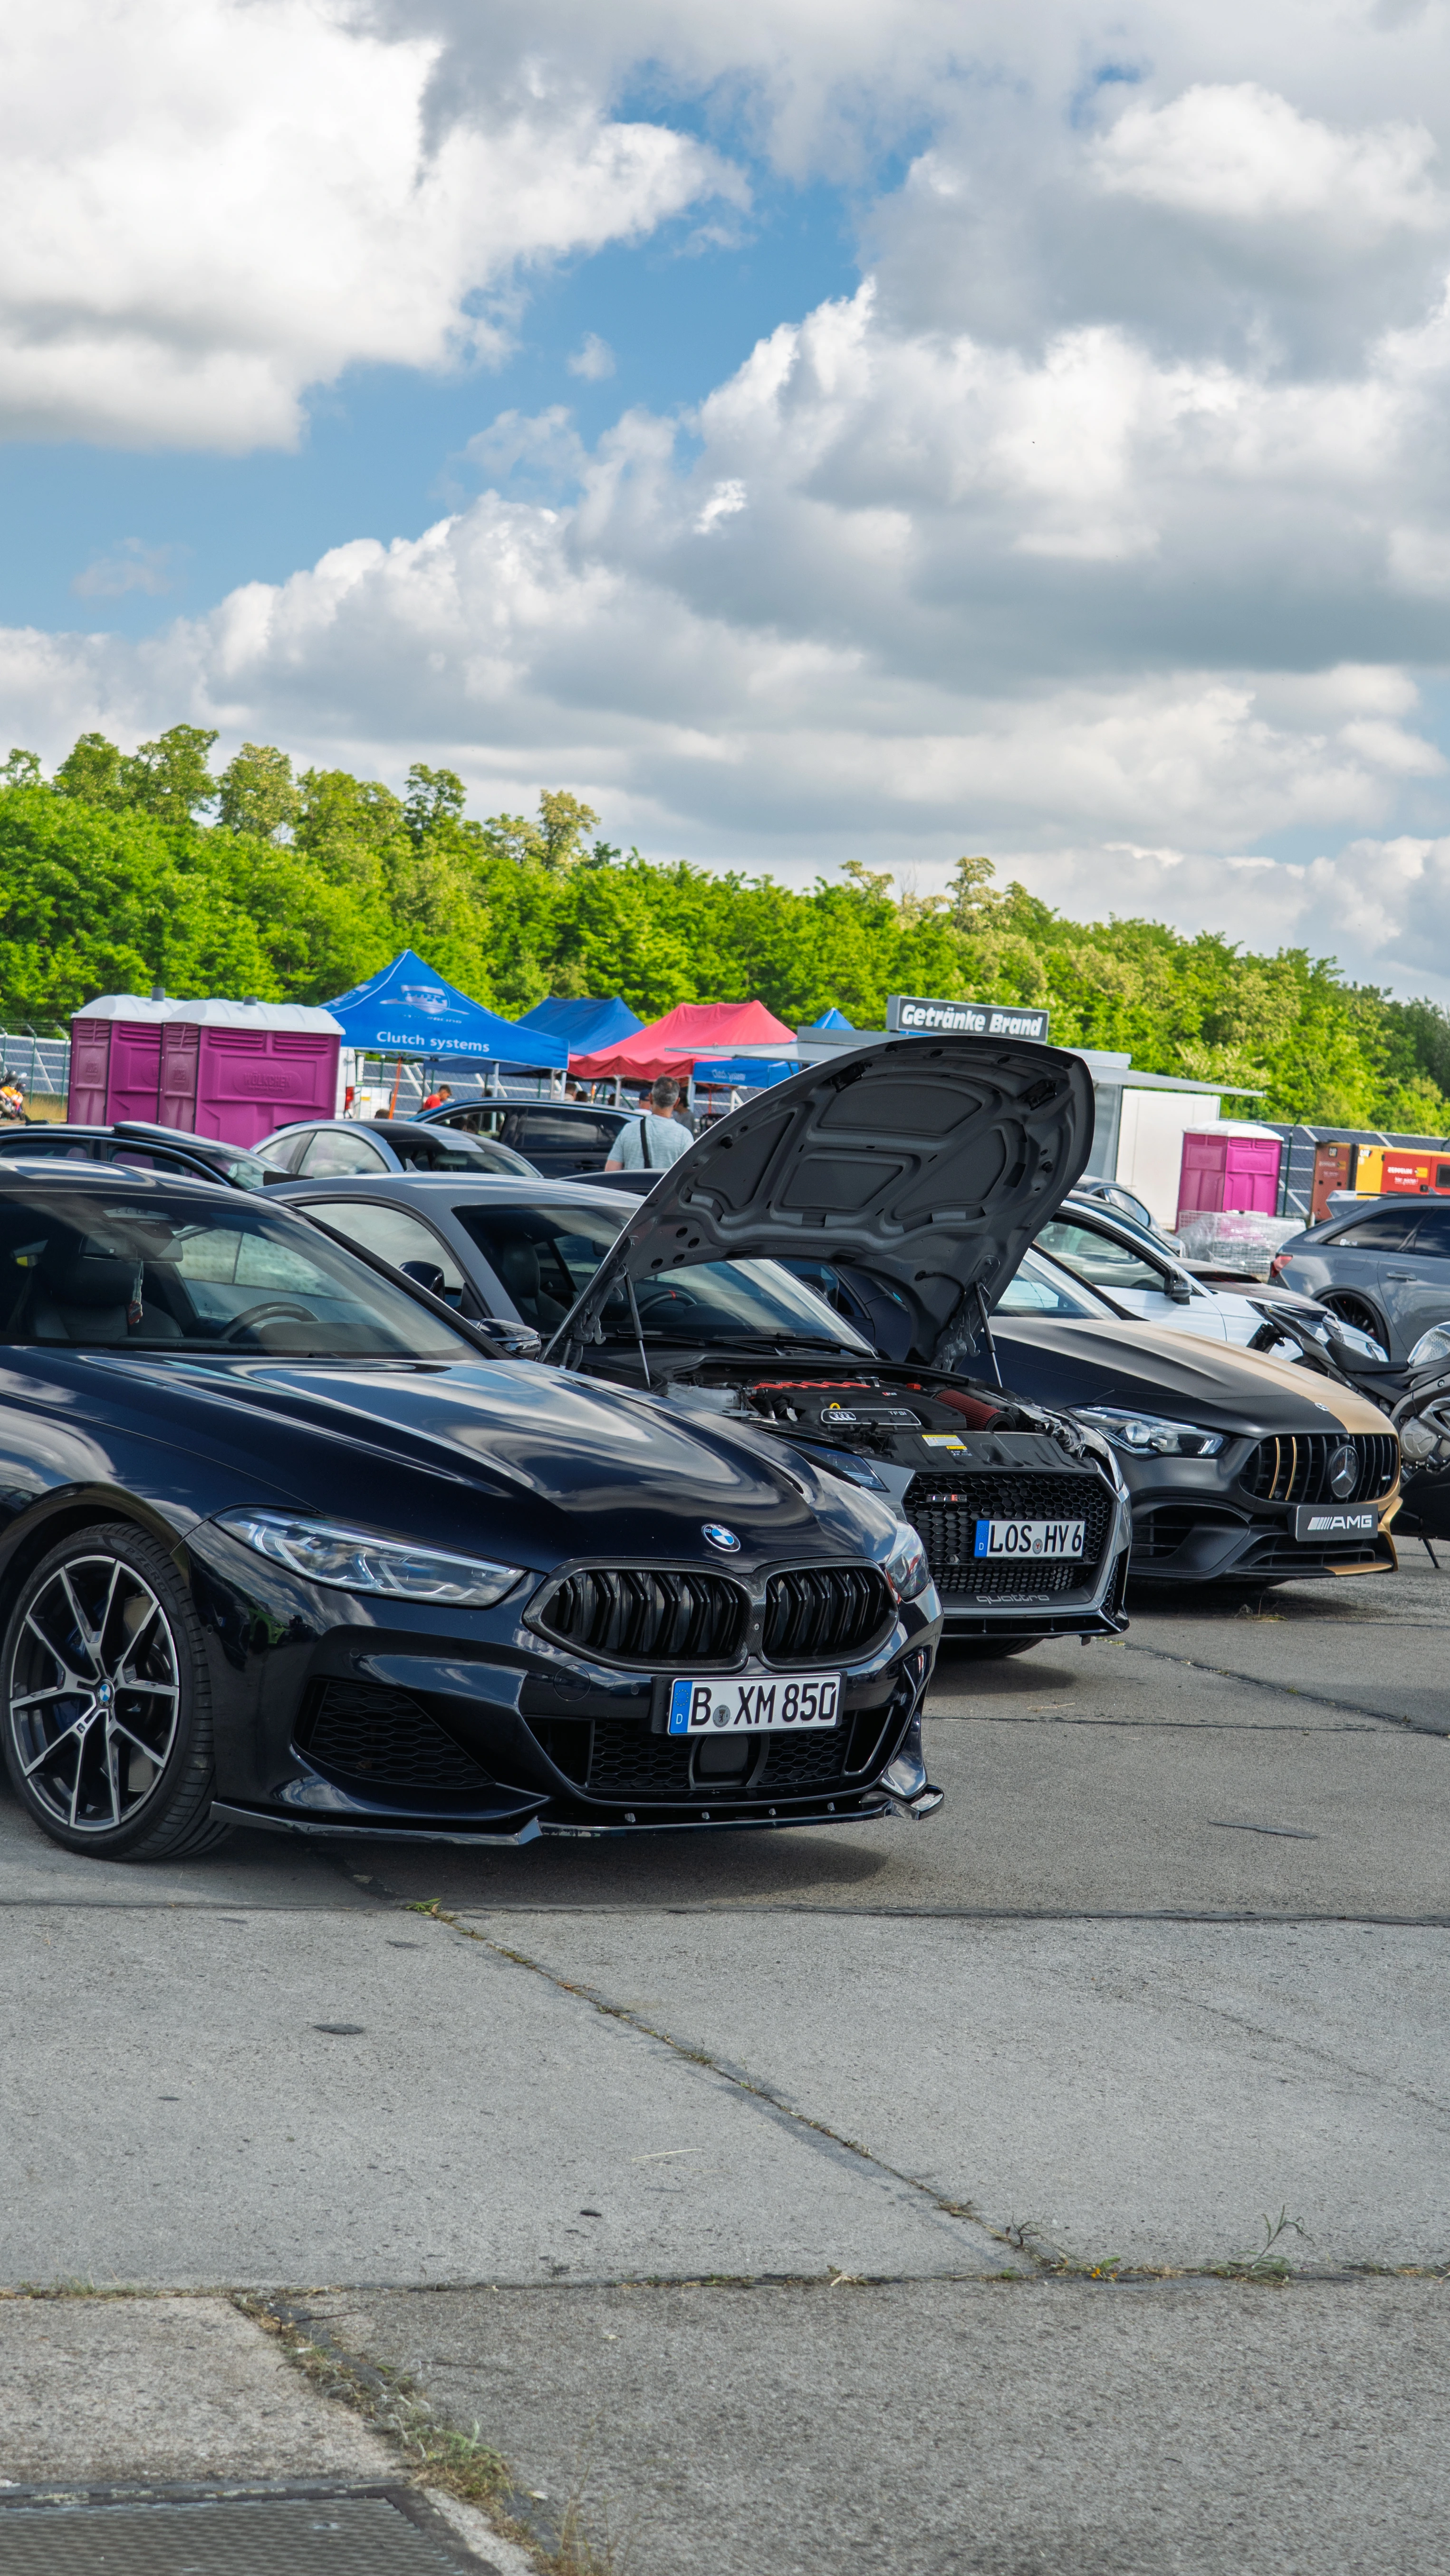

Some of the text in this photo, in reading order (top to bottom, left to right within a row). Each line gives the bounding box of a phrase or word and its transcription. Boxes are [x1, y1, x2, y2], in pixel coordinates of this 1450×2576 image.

[901, 1004, 1043, 1036] Getränke Brand
[376, 1031, 490, 1052] Clutch systems
[1330, 1514, 1372, 1530] AMG
[979, 1542, 984, 1551] D
[989, 1524, 1083, 1552] LOS HY 6
[976, 1594, 1050, 1604] quattro
[691, 1686, 712, 1726] B
[733, 1684, 776, 1725] XM
[781, 1681, 837, 1723] 850
[676, 1713, 683, 1725] D
